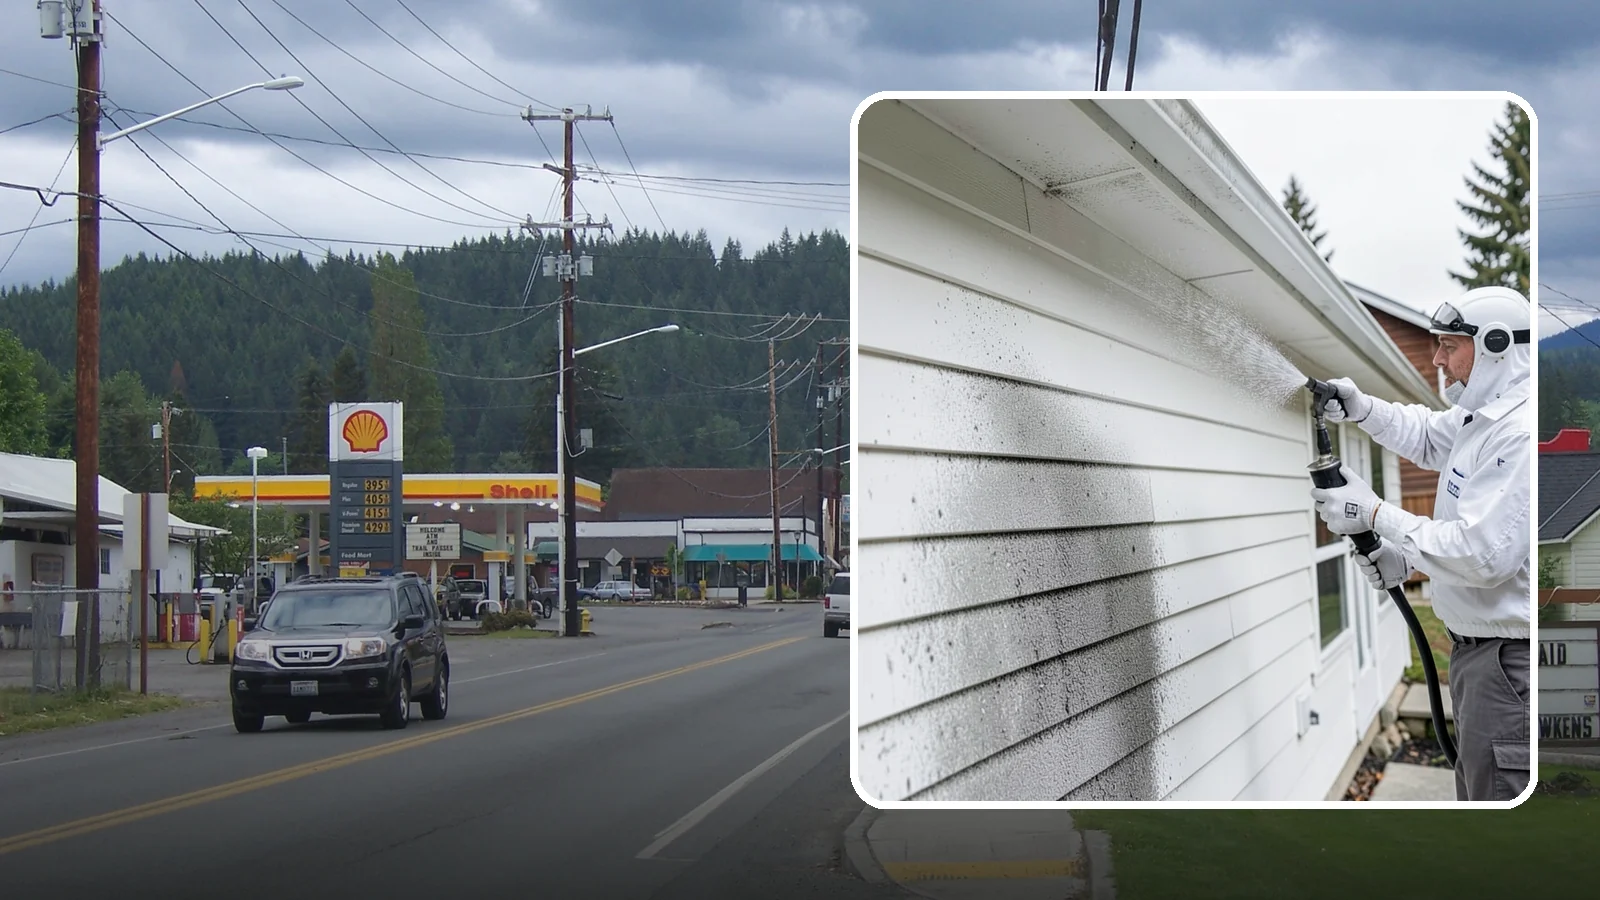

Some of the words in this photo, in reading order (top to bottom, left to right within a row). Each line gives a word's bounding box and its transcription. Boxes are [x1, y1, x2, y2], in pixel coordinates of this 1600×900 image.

[366, 480, 383, 490] 395
[490, 484, 547, 498] Shell
[366, 494, 383, 504] 405
[366, 508, 383, 518] 415
[366, 522, 383, 532] 429
